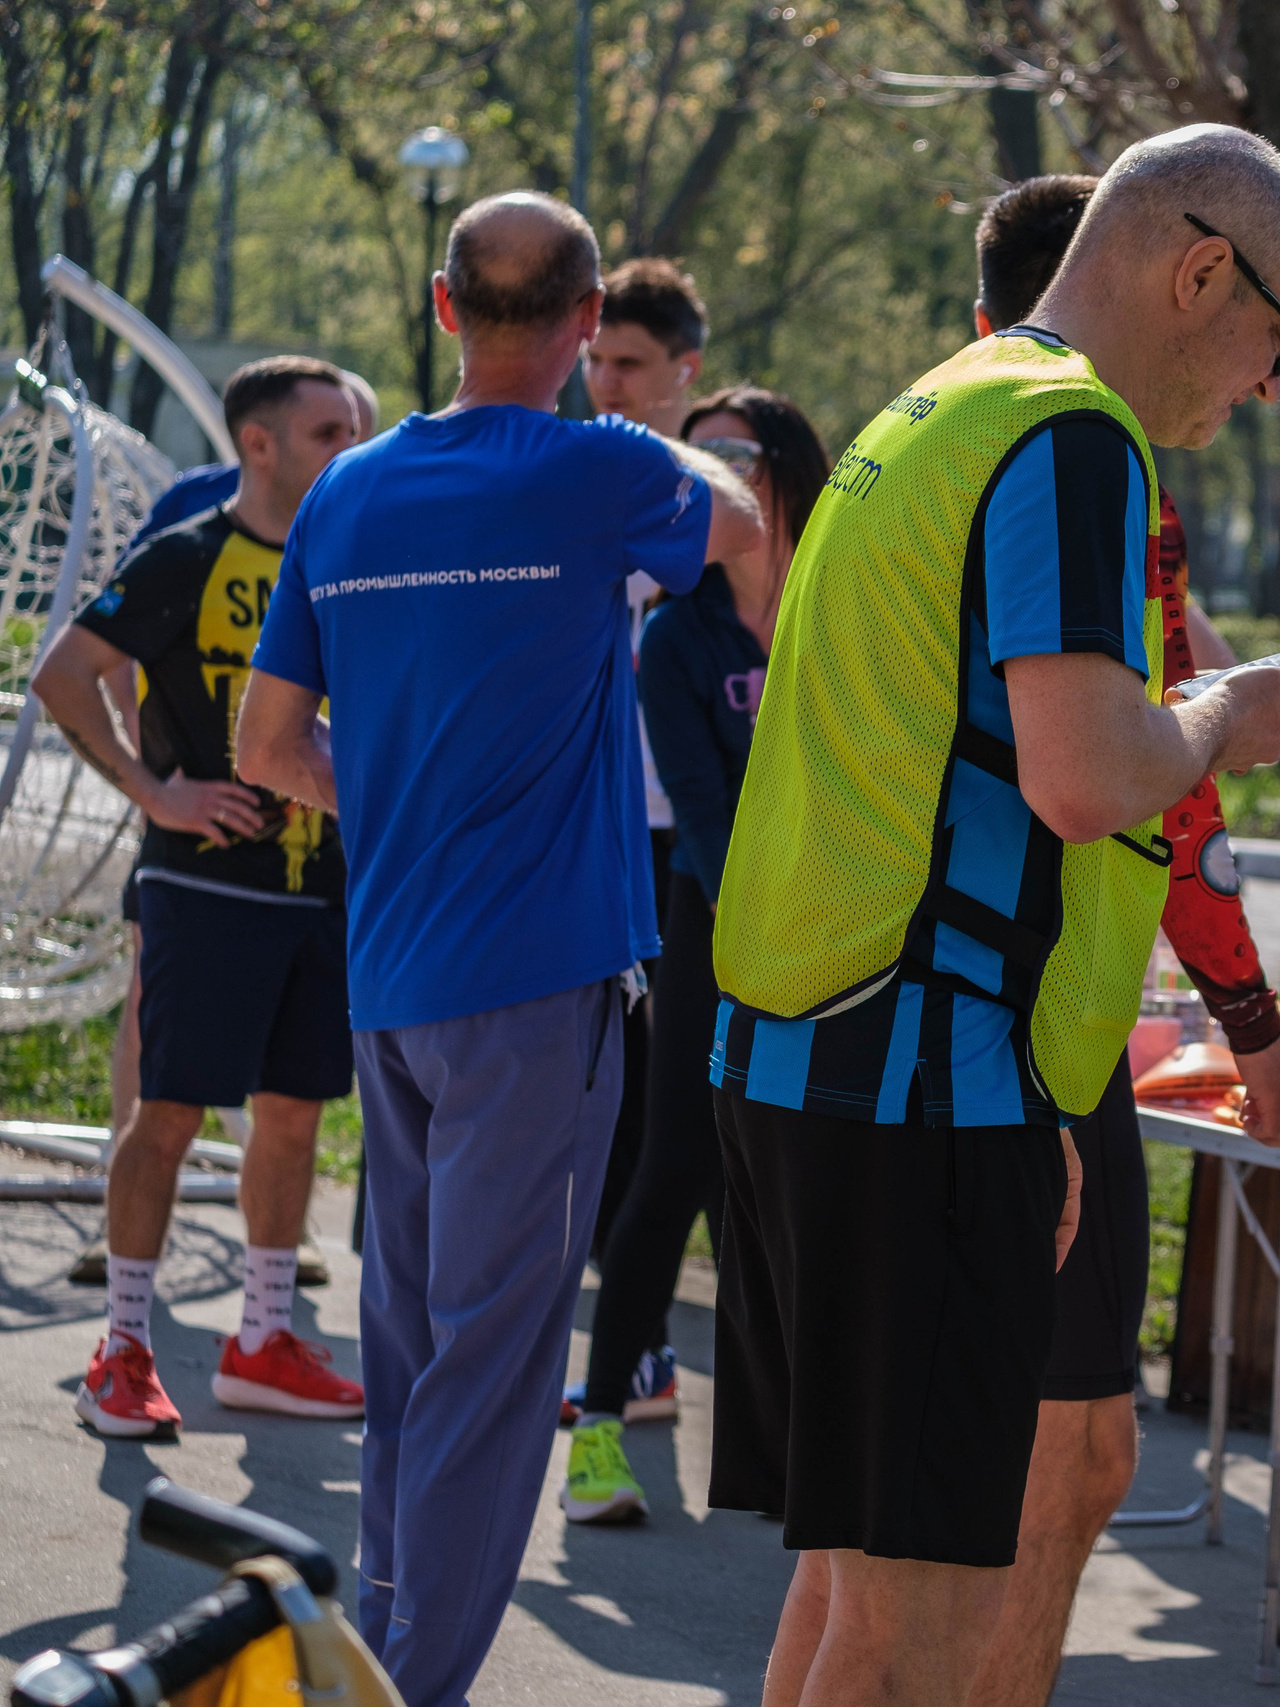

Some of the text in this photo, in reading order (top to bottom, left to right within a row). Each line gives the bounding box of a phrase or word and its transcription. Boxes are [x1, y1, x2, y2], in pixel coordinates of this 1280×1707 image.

[326, 582, 339, 598] ЗА
[339, 569, 476, 595] ПРОМЫШЛЕННОСТЬ
[480, 564, 560, 583] МОСКВЫ!
